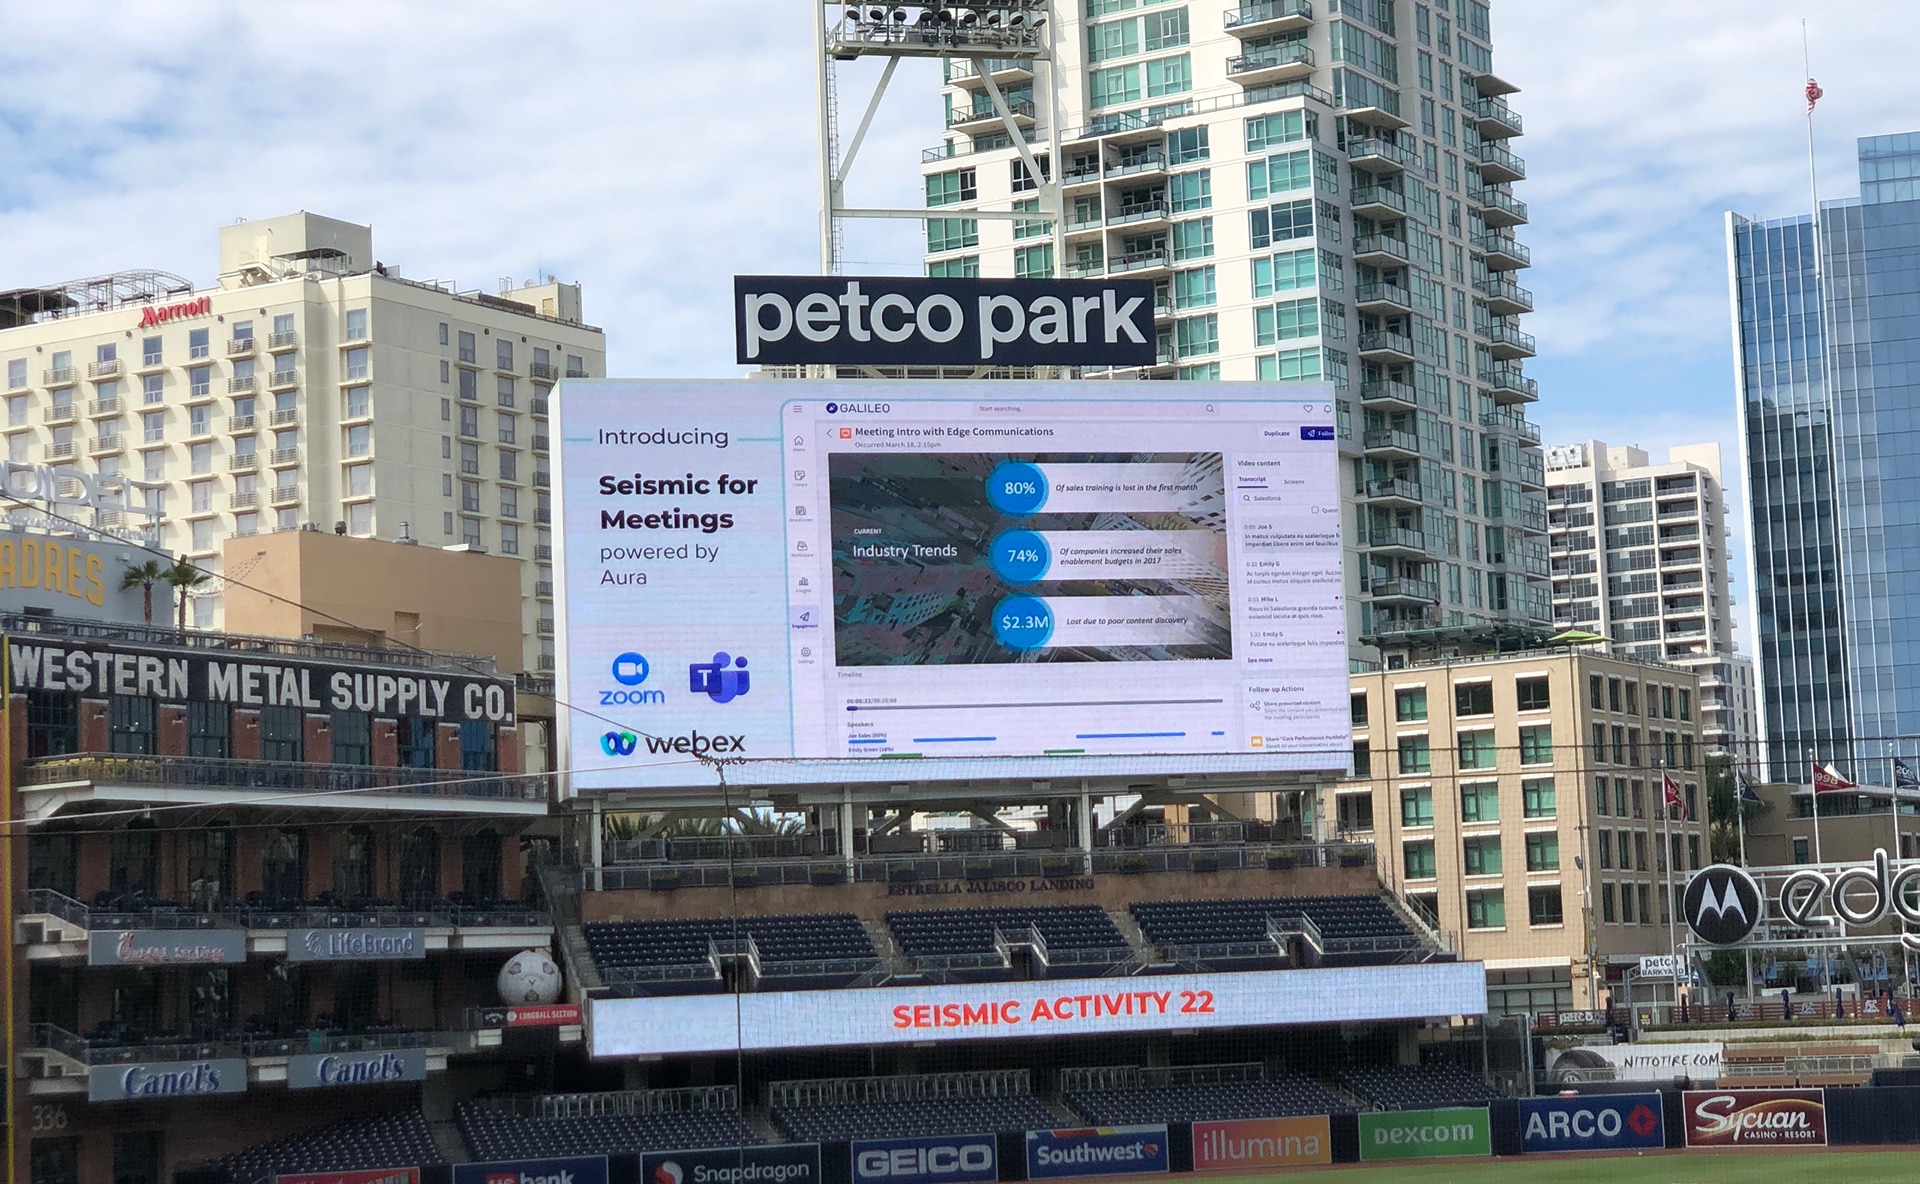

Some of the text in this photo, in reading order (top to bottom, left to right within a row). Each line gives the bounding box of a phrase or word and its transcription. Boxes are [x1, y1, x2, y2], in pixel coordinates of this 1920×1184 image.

[137, 295, 212, 328] Marriott
[745, 281, 1148, 359] petco park
[839, 403, 891, 414] GALILEO
[598, 427, 730, 449] Introducing
[855, 426, 1054, 438] Meeting Intro with Edge Communications
[854, 441, 884, 449] Occurred
[885, 441, 906, 449] March
[0, 458, 167, 518] UIDEL
[598, 472, 759, 495] Seismic for
[1004, 481, 1037, 495] 80%
[1055, 484, 1065, 493] Of
[1066, 484, 1084, 492] sales
[1085, 484, 1114, 493] training
[1115, 483, 1122, 491] is
[1145, 483, 1157, 491] the
[1158, 483, 1173, 493] first
[1174, 483, 1198, 491] month
[600, 506, 735, 534] Meetings
[600, 543, 719, 563] powered by
[853, 544, 958, 559] Industry Trends
[1007, 549, 1039, 563] 74%
[1059, 546, 1182, 556] Of companies increased their sales
[1060, 557, 1162, 567] enablement budgets in 2017
[600, 569, 648, 585] Aura
[1002, 614, 1049, 631] $2.3M
[1082, 617, 1097, 625] due
[1107, 618, 1125, 626] poor
[1125, 617, 1153, 625] content
[1154, 617, 1189, 625] discovery
[8, 643, 514, 723] WESTERN METAL SUPPLY CO.
[599, 689, 666, 706] zoom
[644, 729, 747, 755] webex
[887, 877, 1095, 897] ESTRELLA JALISCO LANDING
[328, 931, 415, 957] LifeBrand
[1642, 967, 1684, 976] BARKYAD
[518, 1008, 578, 1020] LONGBALL SECTION
[892, 989, 1215, 1029] SEISMIC ACTIVITY 22
[317, 1052, 404, 1085] Canel's
[1623, 1052, 1720, 1069] NITTOTIRE.COM
[123, 1062, 222, 1096] Canel's
[31, 1104, 69, 1132] 336
[1524, 1108, 1623, 1140] ARCO
[1695, 1095, 1811, 1141] Sycuan
[1743, 1129, 1817, 1139] CASINO RESORT
[1037, 1141, 1145, 1166] Southwest
[1203, 1129, 1320, 1161] illumina
[857, 1144, 994, 1178] GEICO
[519, 1170, 574, 1184] bank
[693, 1160, 811, 1184] Snapdragon
